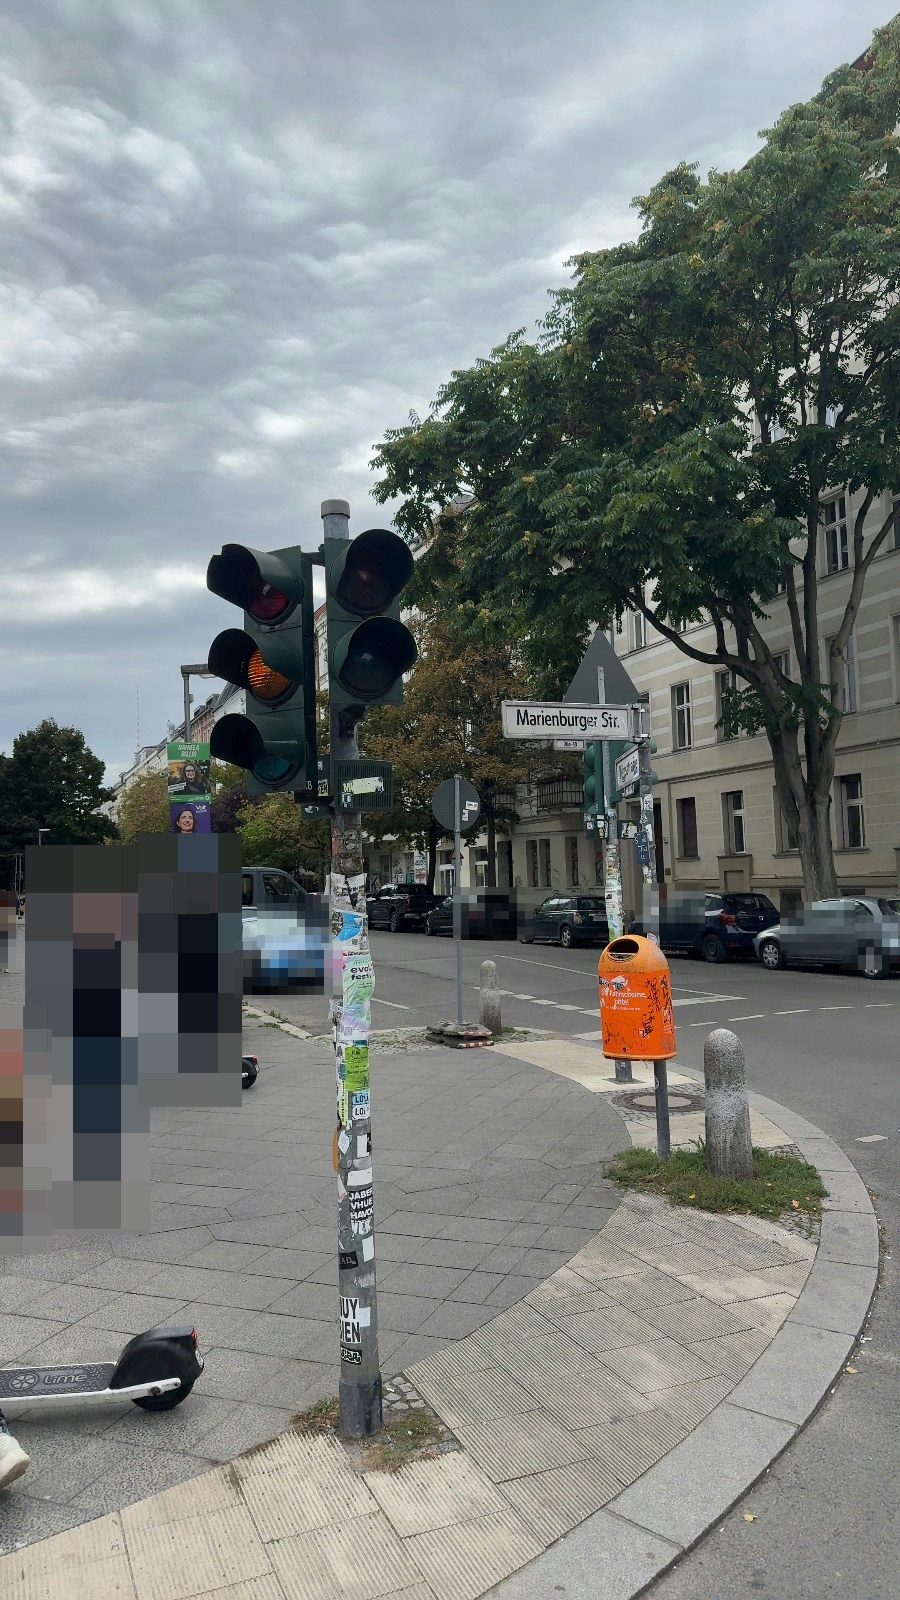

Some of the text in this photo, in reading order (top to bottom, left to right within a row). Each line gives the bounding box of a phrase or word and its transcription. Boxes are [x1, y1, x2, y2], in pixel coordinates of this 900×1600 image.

[516, 709, 620, 731] Marienburger Str.
[44, 1374, 87, 1384] Lime
